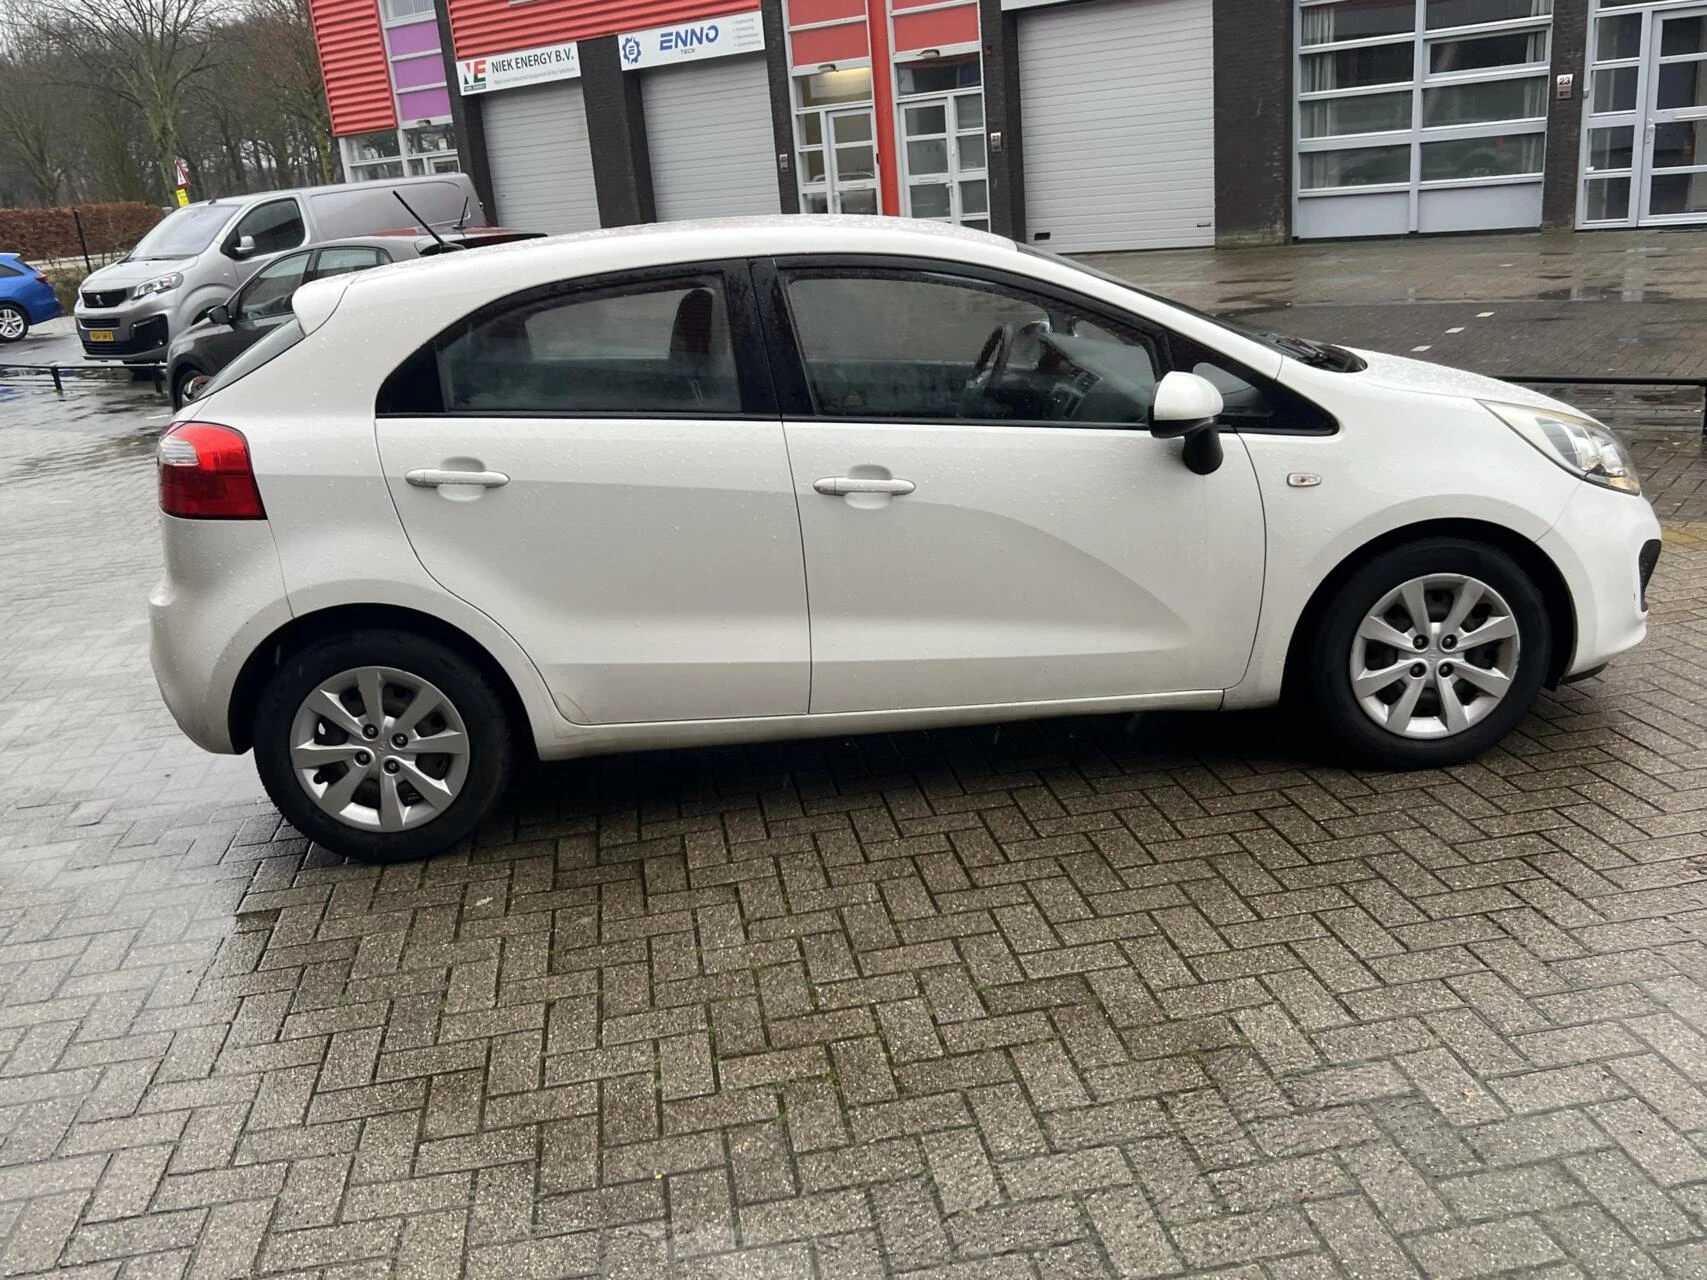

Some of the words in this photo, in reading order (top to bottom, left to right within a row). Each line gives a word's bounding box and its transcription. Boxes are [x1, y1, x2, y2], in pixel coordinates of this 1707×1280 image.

[660, 25, 719, 51] ENNO
[680, 47, 696, 55] TECH
[491, 58, 514, 74] NIEK
[515, 51, 553, 70] ENERGY
[555, 47, 575, 62] B.V.
[1559, 77, 1570, 85] 23
